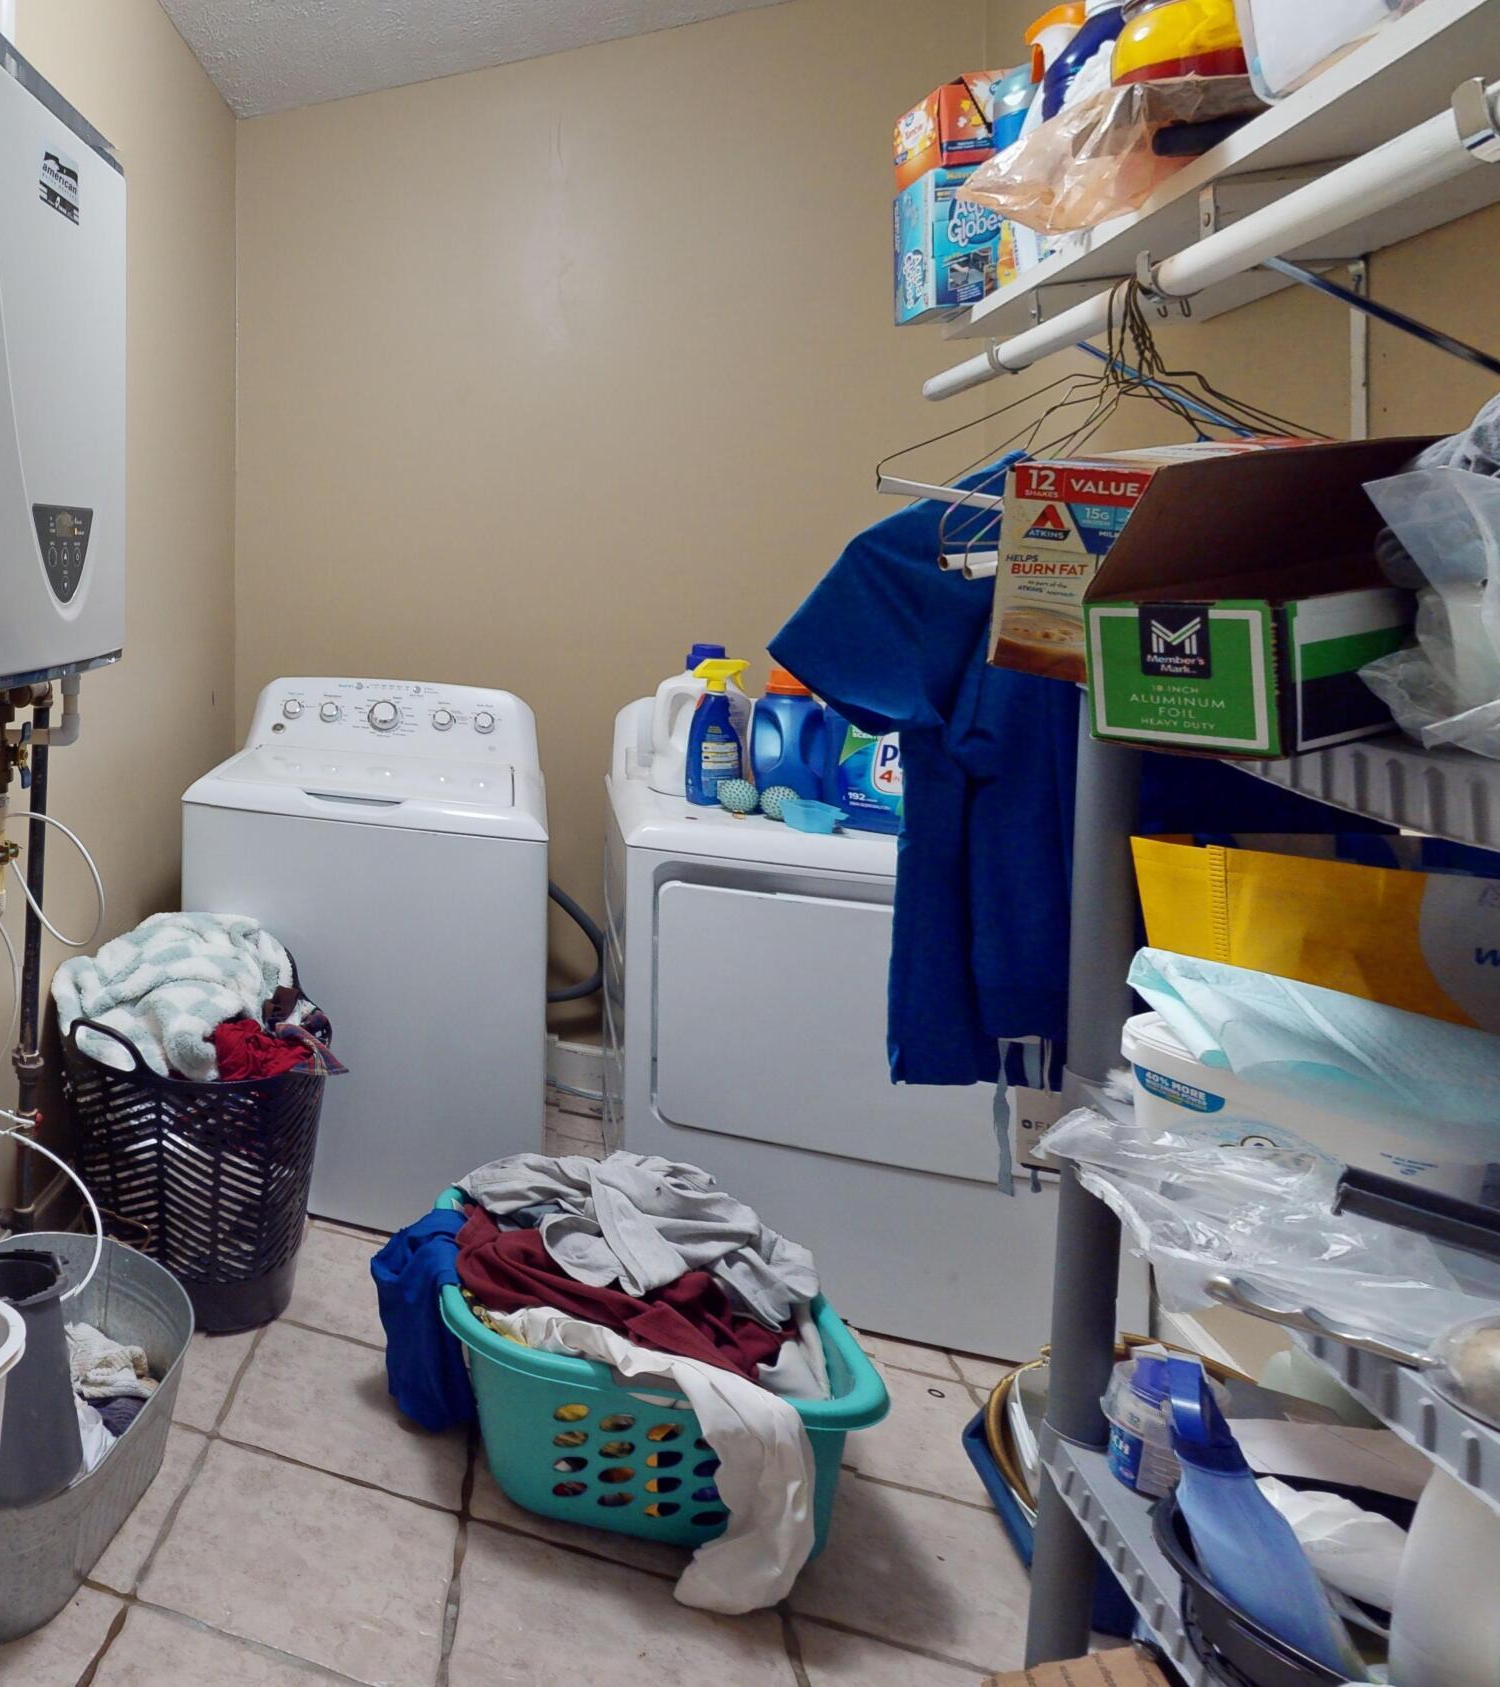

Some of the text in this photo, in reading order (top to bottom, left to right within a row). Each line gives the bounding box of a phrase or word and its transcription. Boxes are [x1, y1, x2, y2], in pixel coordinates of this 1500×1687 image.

[42, 162, 78, 195] american
[1028, 469, 1056, 491] 12
[1024, 489, 1059, 499] SHAKES
[1070, 478, 1141, 497] VALUE
[1028, 528, 1065, 540] ATKINS
[1005, 553, 1039, 563] HELPS
[1011, 563, 1089, 576] BURN FAT
[1146, 654, 1206, 666] Member's
[1168, 686, 1199, 694] INCH
[1129, 693, 1226, 709] ALUMINUM
[1158, 706, 1197, 719] FOIL
[1141, 718, 1216, 730] HEAVY DUTY
[1145, 1071, 1170, 1087] 40%
[1170, 1080, 1207, 1101] MORE
